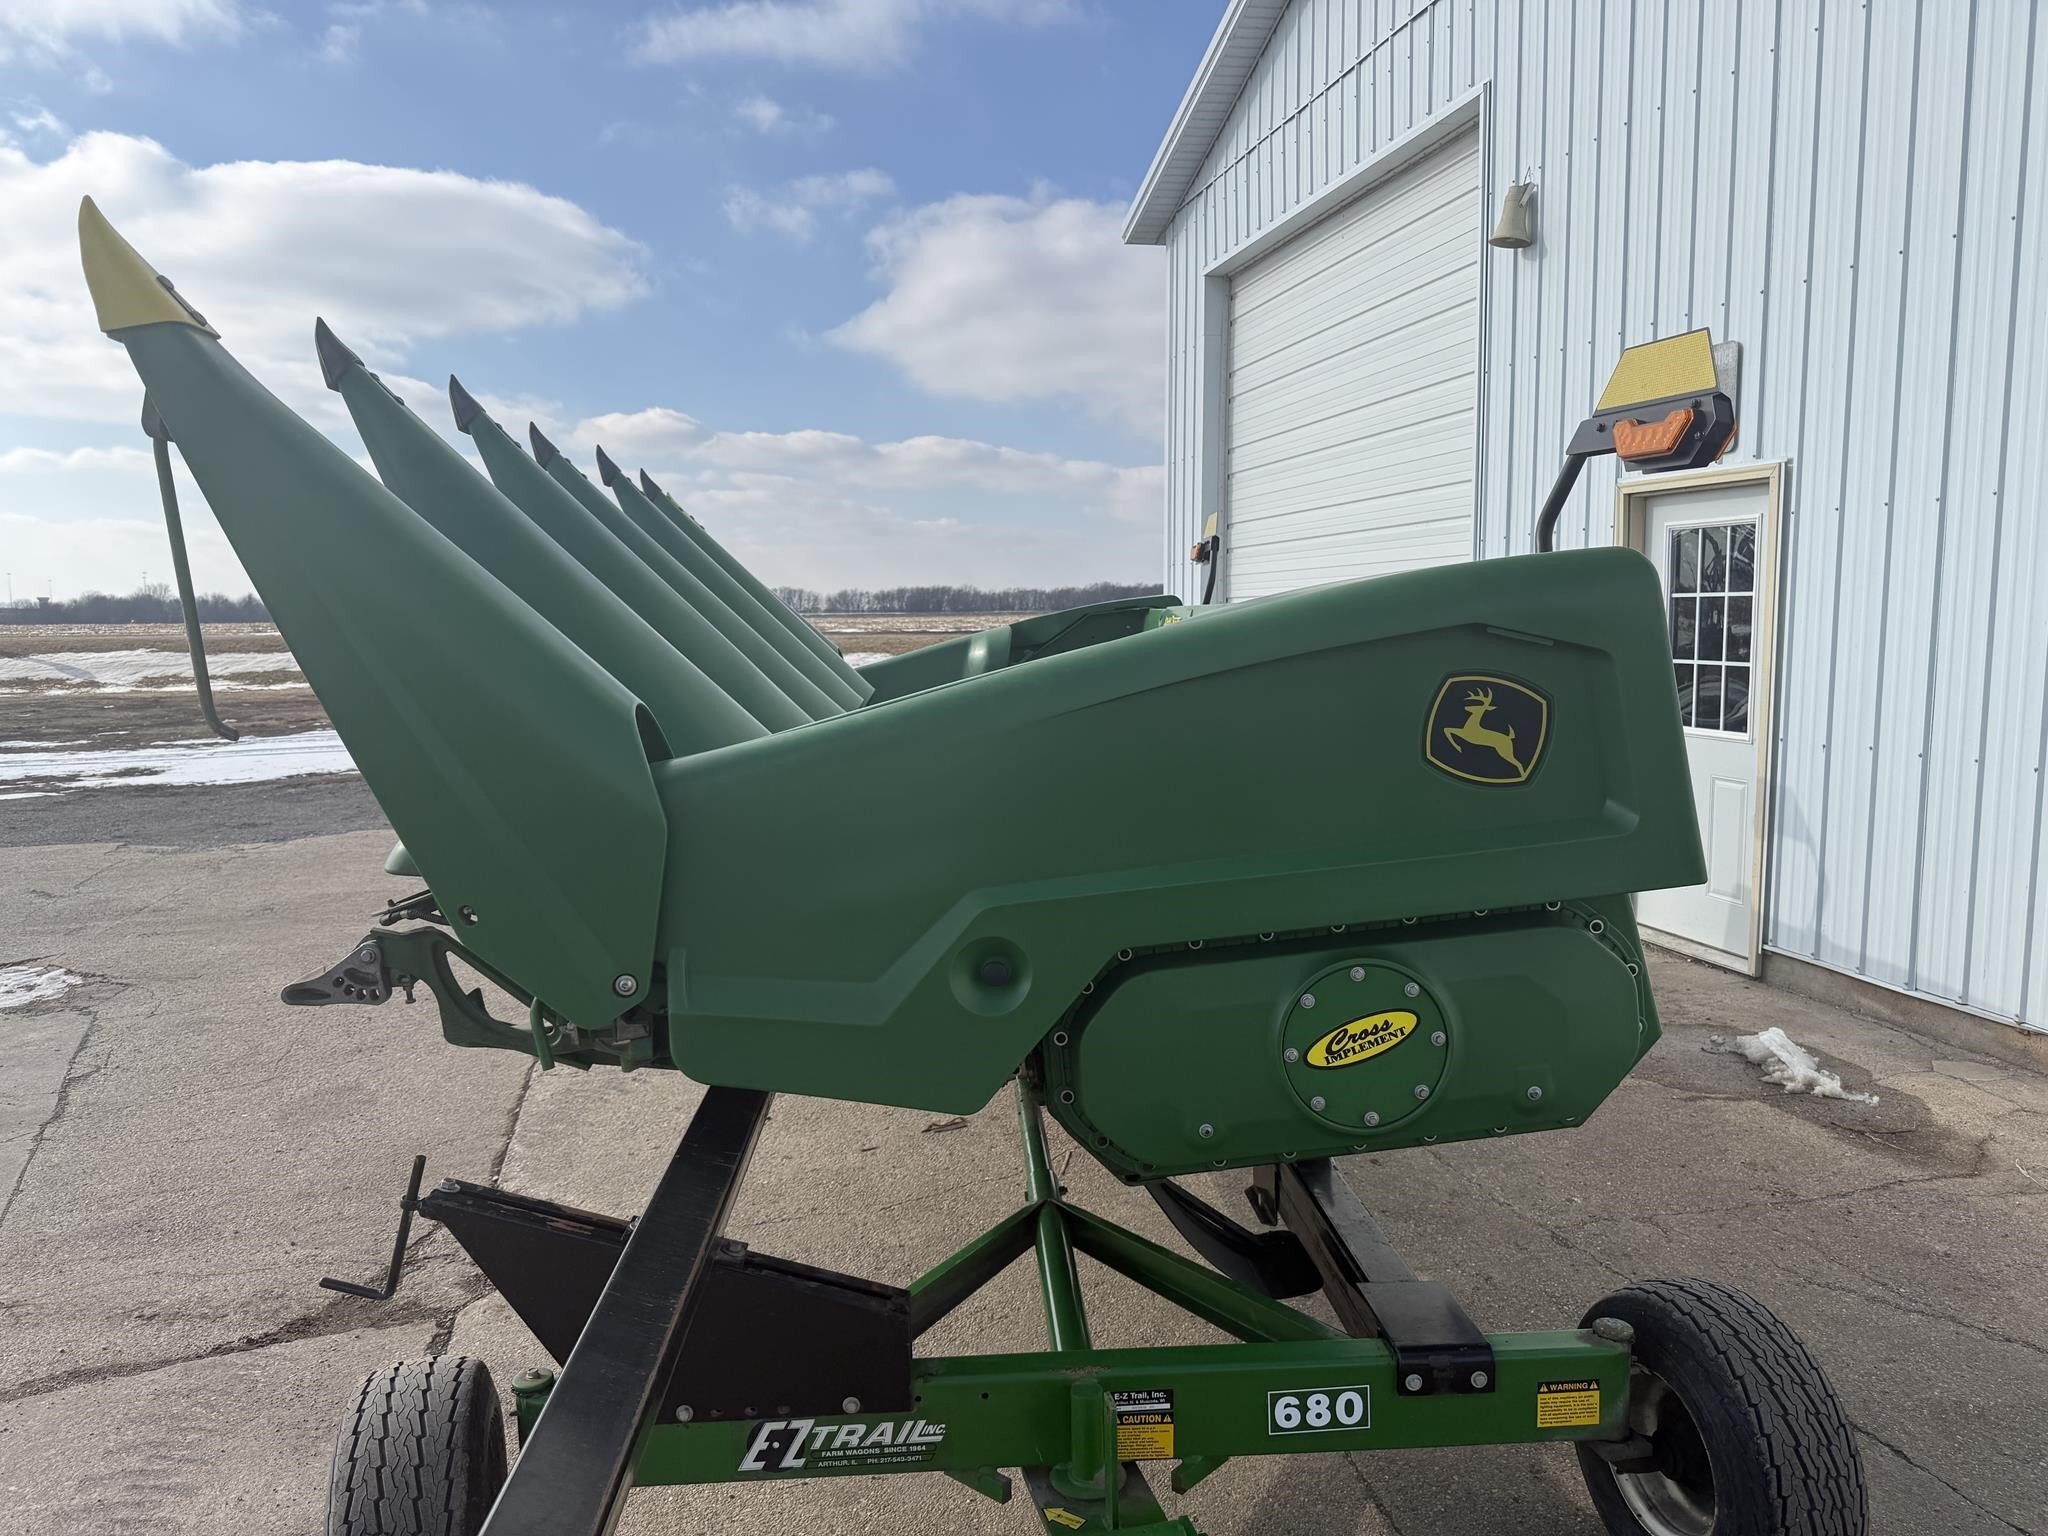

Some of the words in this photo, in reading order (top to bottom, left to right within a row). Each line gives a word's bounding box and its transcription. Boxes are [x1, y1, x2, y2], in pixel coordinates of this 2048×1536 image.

[1324, 1026, 1406, 1066] IMPLEMENT
[1325, 1019, 1394, 1056] Cross
[1130, 1391, 1149, 1399] Trail,
[1550, 1382, 1588, 1391] WARNING
[1122, 1414, 1162, 1424] CAUTION
[1274, 1391, 1364, 1429] 680
[810, 1420, 944, 1450] TRAIL
[921, 1424, 946, 1435] INC.
[821, 1449, 844, 1458] FARM
[845, 1447, 880, 1456] WAGONS
[884, 1445, 907, 1453] SINCE
